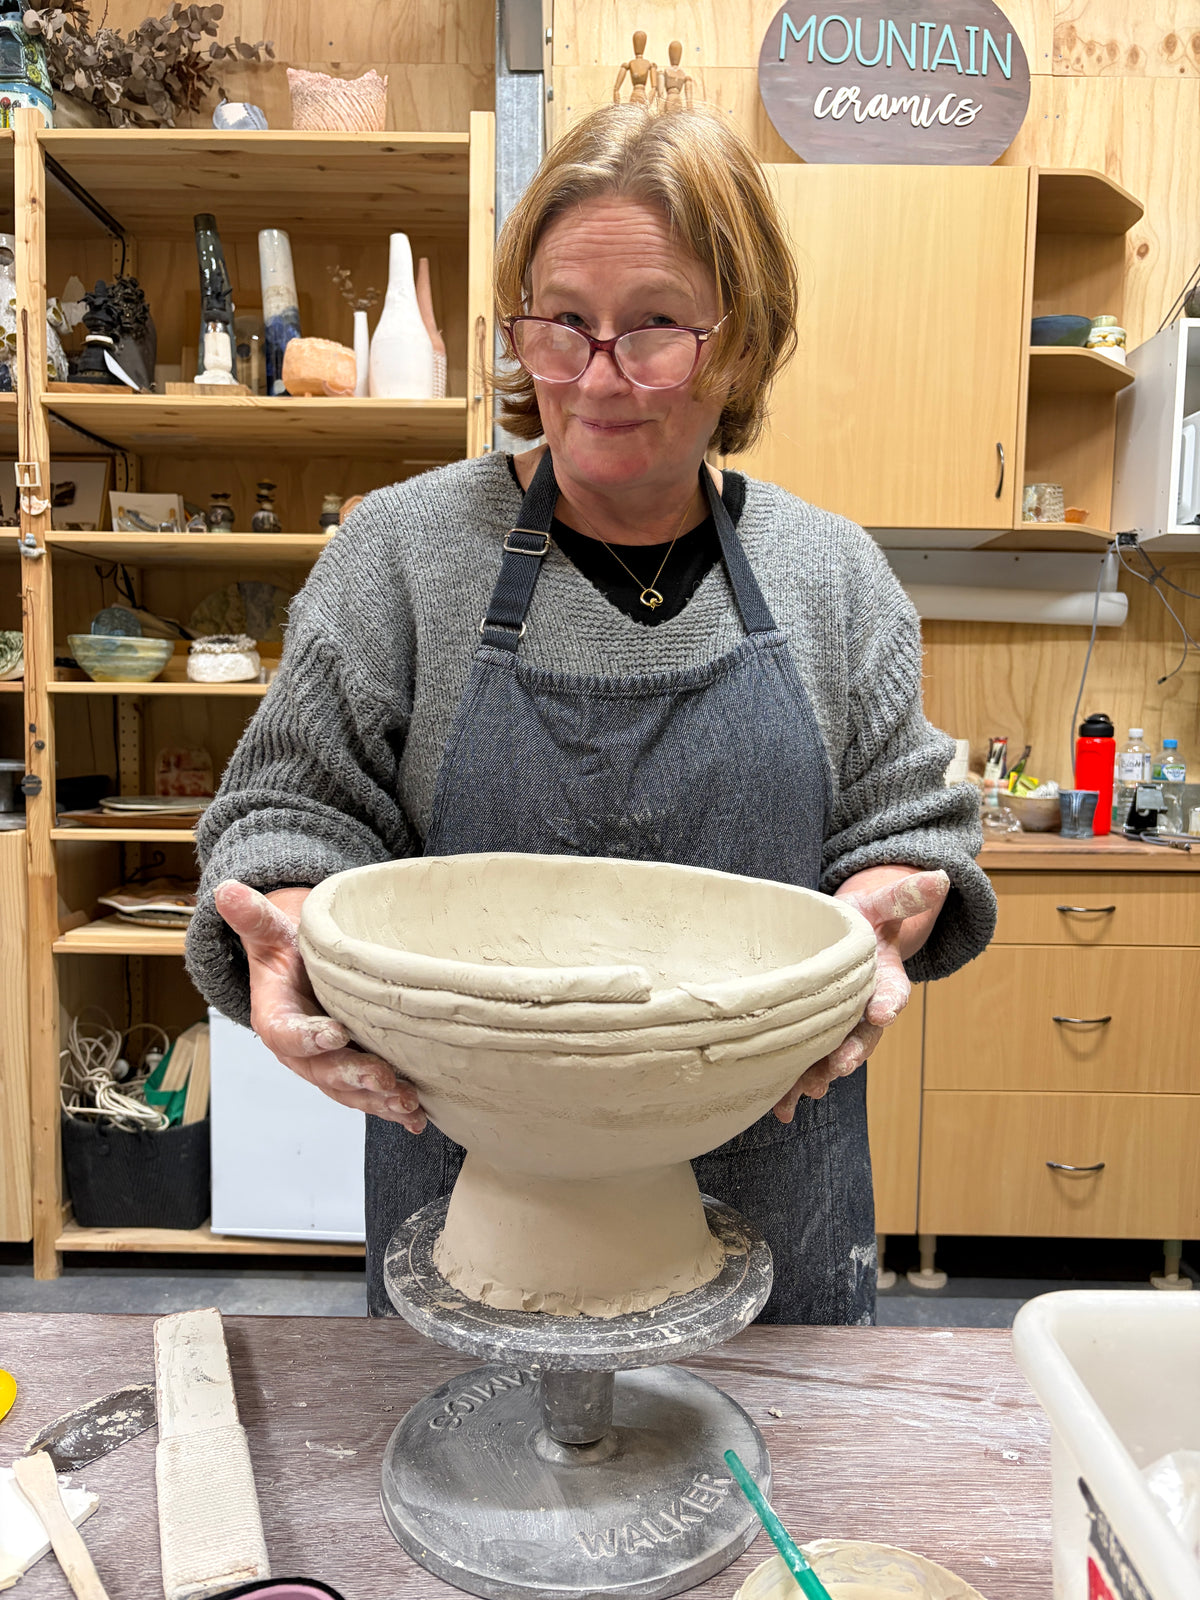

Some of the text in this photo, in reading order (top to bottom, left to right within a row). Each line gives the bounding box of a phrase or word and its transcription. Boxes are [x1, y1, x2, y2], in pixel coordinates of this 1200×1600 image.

[779, 12, 1012, 79] MOUNTAIN
[813, 86, 983, 128] ceramics
[577, 1472, 734, 1560] WALKER
